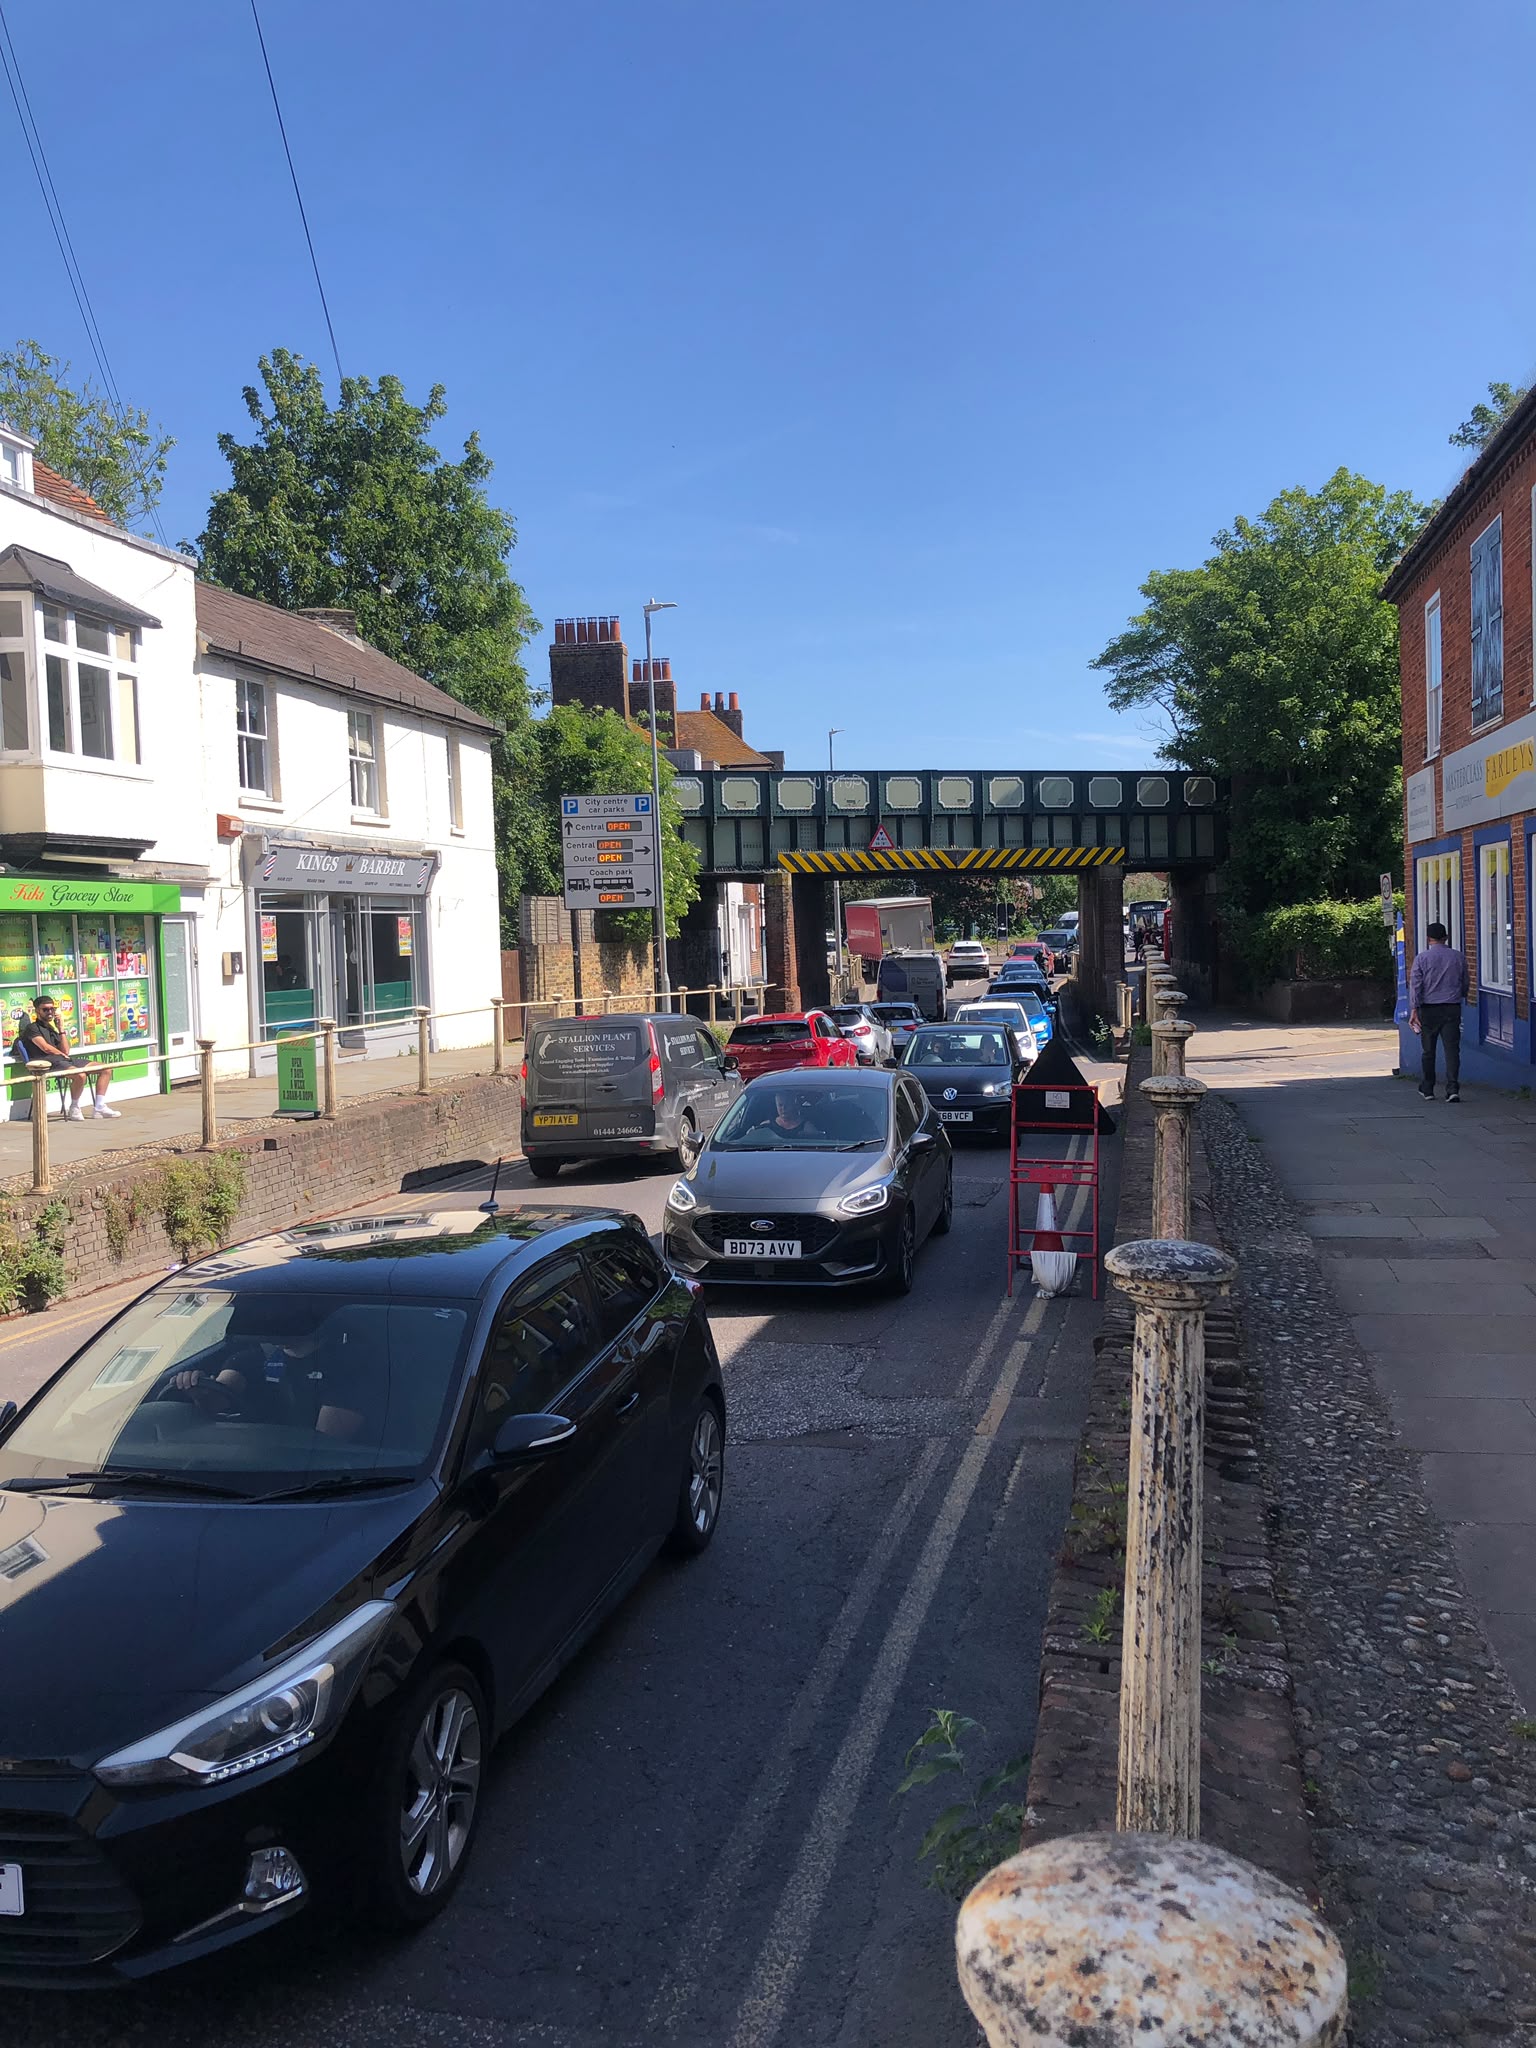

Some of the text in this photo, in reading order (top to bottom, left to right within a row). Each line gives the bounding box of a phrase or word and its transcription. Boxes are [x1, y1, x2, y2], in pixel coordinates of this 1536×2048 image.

[568, 800, 576, 813] P
[638, 799, 647, 810] P
[607, 822, 630, 831] OPEN
[599, 841, 621, 849] OPEN
[296, 854, 406, 876] KINGS BARBER
[10, 884, 134, 906] Kiki Grocery Store
[559, 1034, 600, 1043] STALLION
[573, 1044, 616, 1052] SERVICES
[101, 1050, 124, 1063] WEEK
[539, 1116, 556, 1124] YP71
[730, 1241, 795, 1256] BD73 AVV
